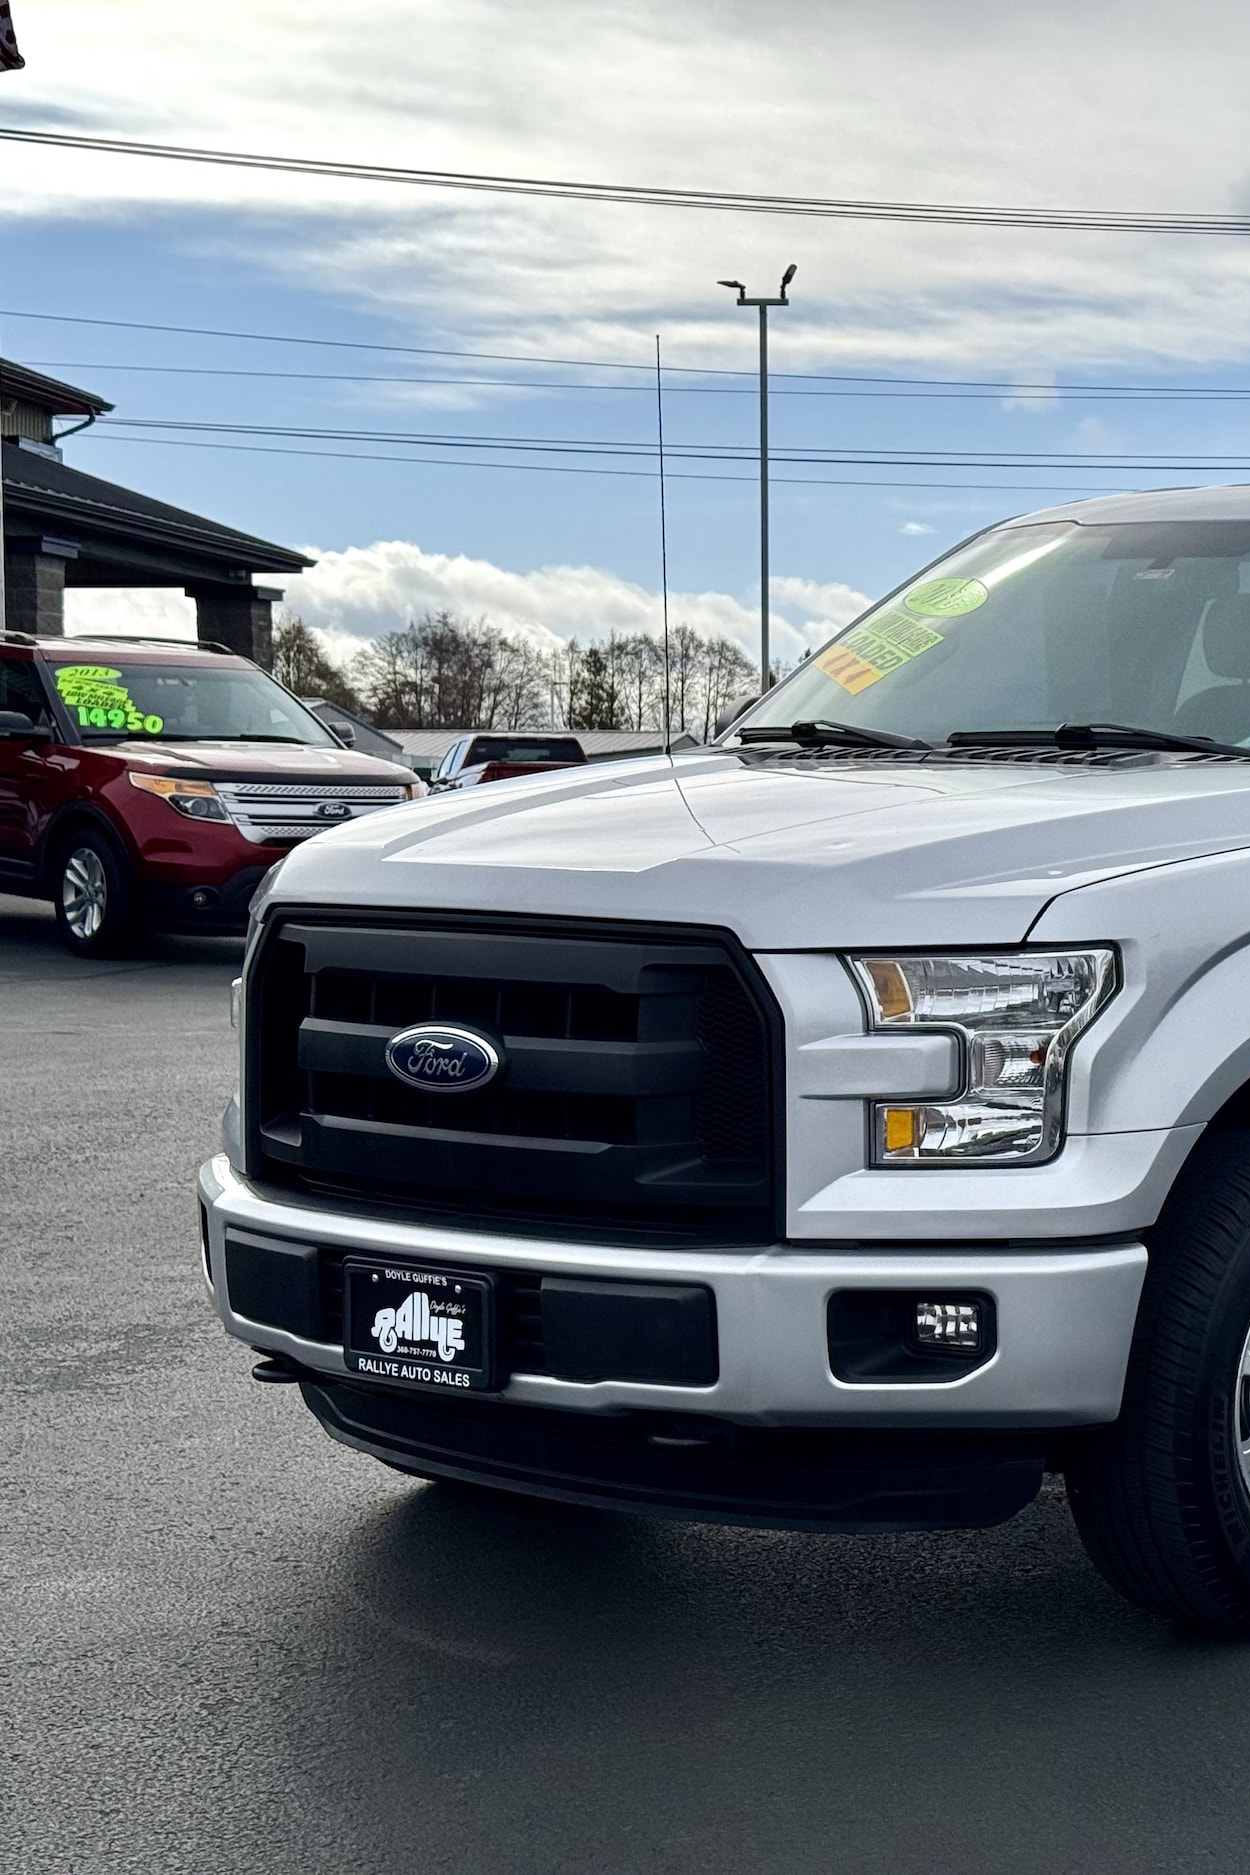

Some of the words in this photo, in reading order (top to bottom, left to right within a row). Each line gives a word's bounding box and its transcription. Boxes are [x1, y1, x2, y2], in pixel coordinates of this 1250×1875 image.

[841, 631, 903, 670] LOADED
[78, 706, 163, 734] 14950
[407, 1039, 468, 1077] Ford
[385, 1269, 411, 1282] DOYLE
[412, 1273, 447, 1286] GUFFIE'S
[358, 1358, 399, 1376] RALLYE
[400, 1365, 431, 1381] AUTO
[433, 1370, 470, 1387] SALES
[1211, 1395, 1247, 1546] MICHELIN
